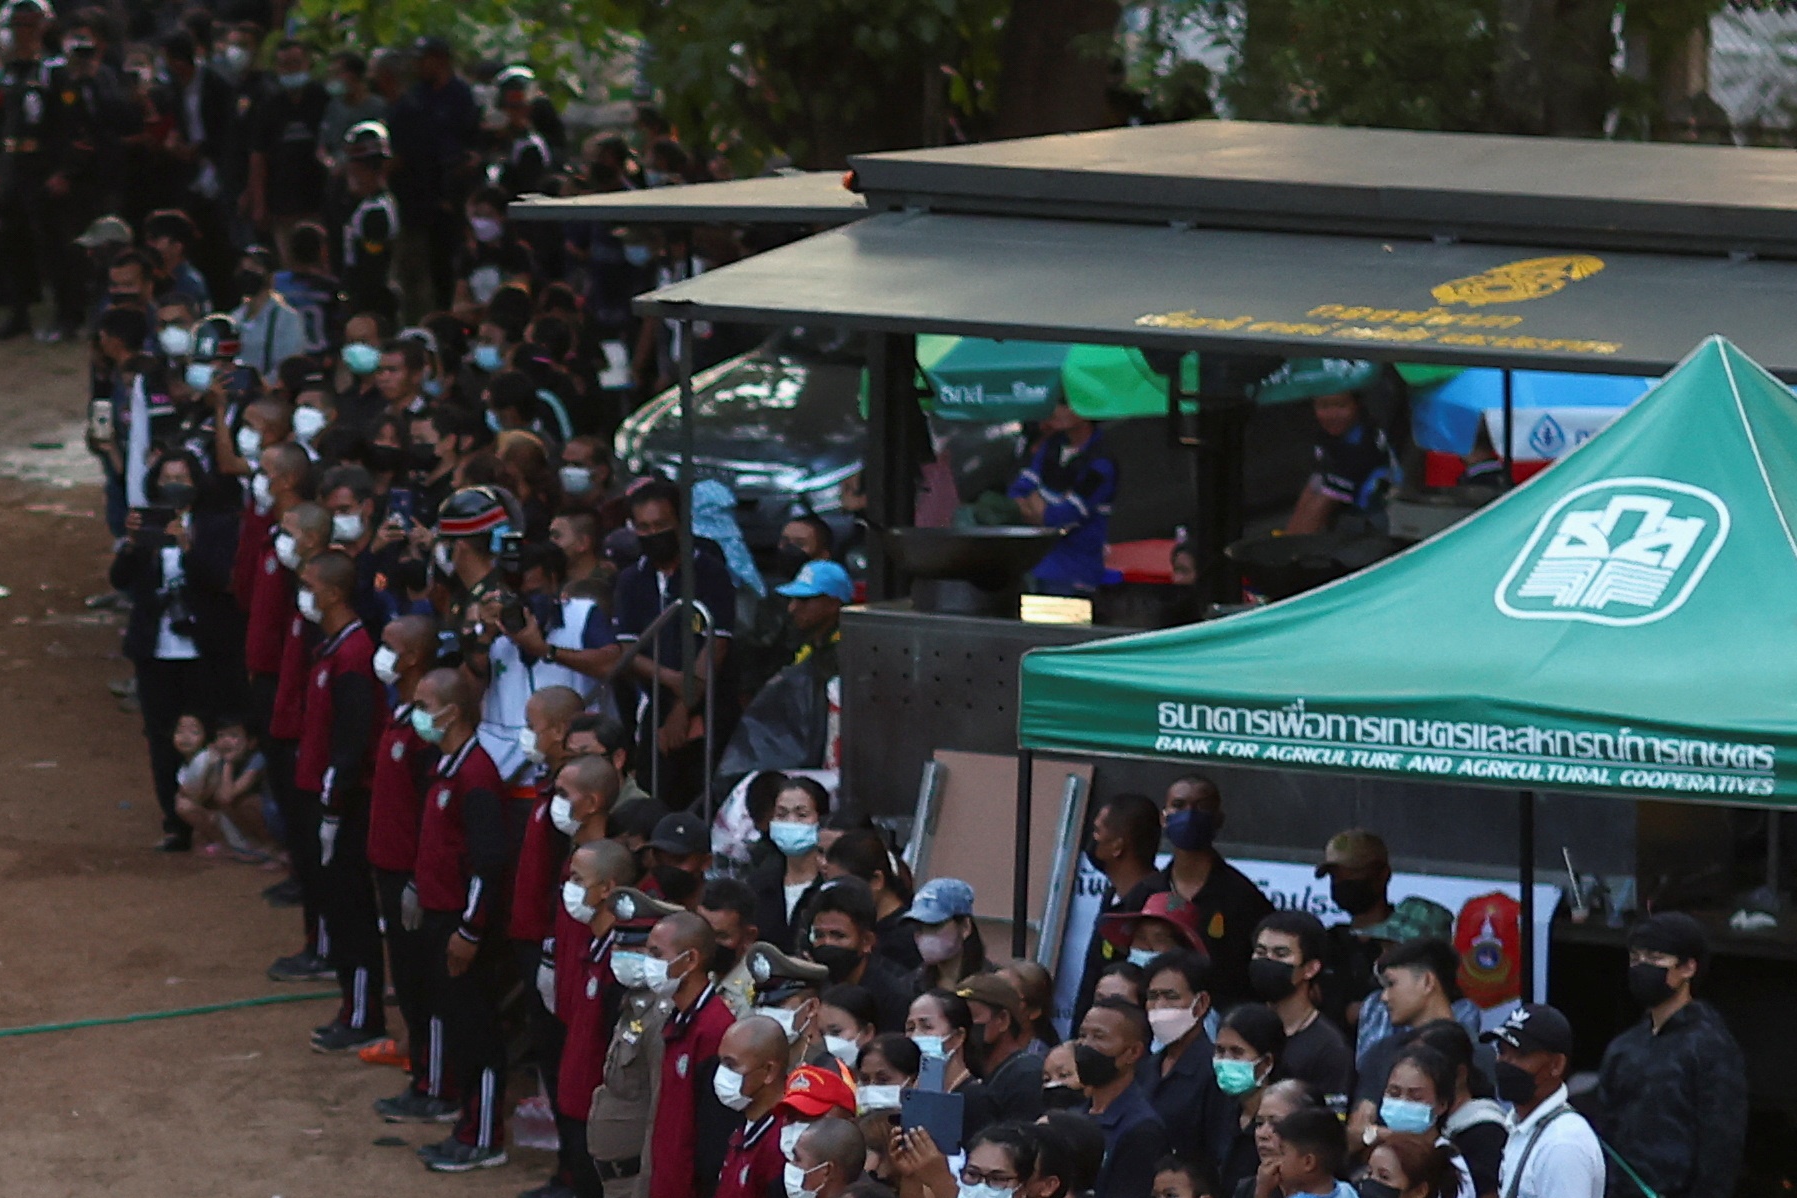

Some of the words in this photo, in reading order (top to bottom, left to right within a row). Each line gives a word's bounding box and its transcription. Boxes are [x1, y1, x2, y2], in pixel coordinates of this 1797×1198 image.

[1155, 736, 1213, 755] BANK
[1216, 741, 1259, 759] FOR
[1262, 744, 1404, 771] AGRICULTURE
[1406, 755, 1454, 774] AND
[1457, 758, 1612, 786] AGRICULTURAL
[1618, 769, 1775, 797] COOPERATIVES
[1158, 698, 1776, 770] ธนาคารเพื่อการเกษตรและสหกรณ์การเกษตร
